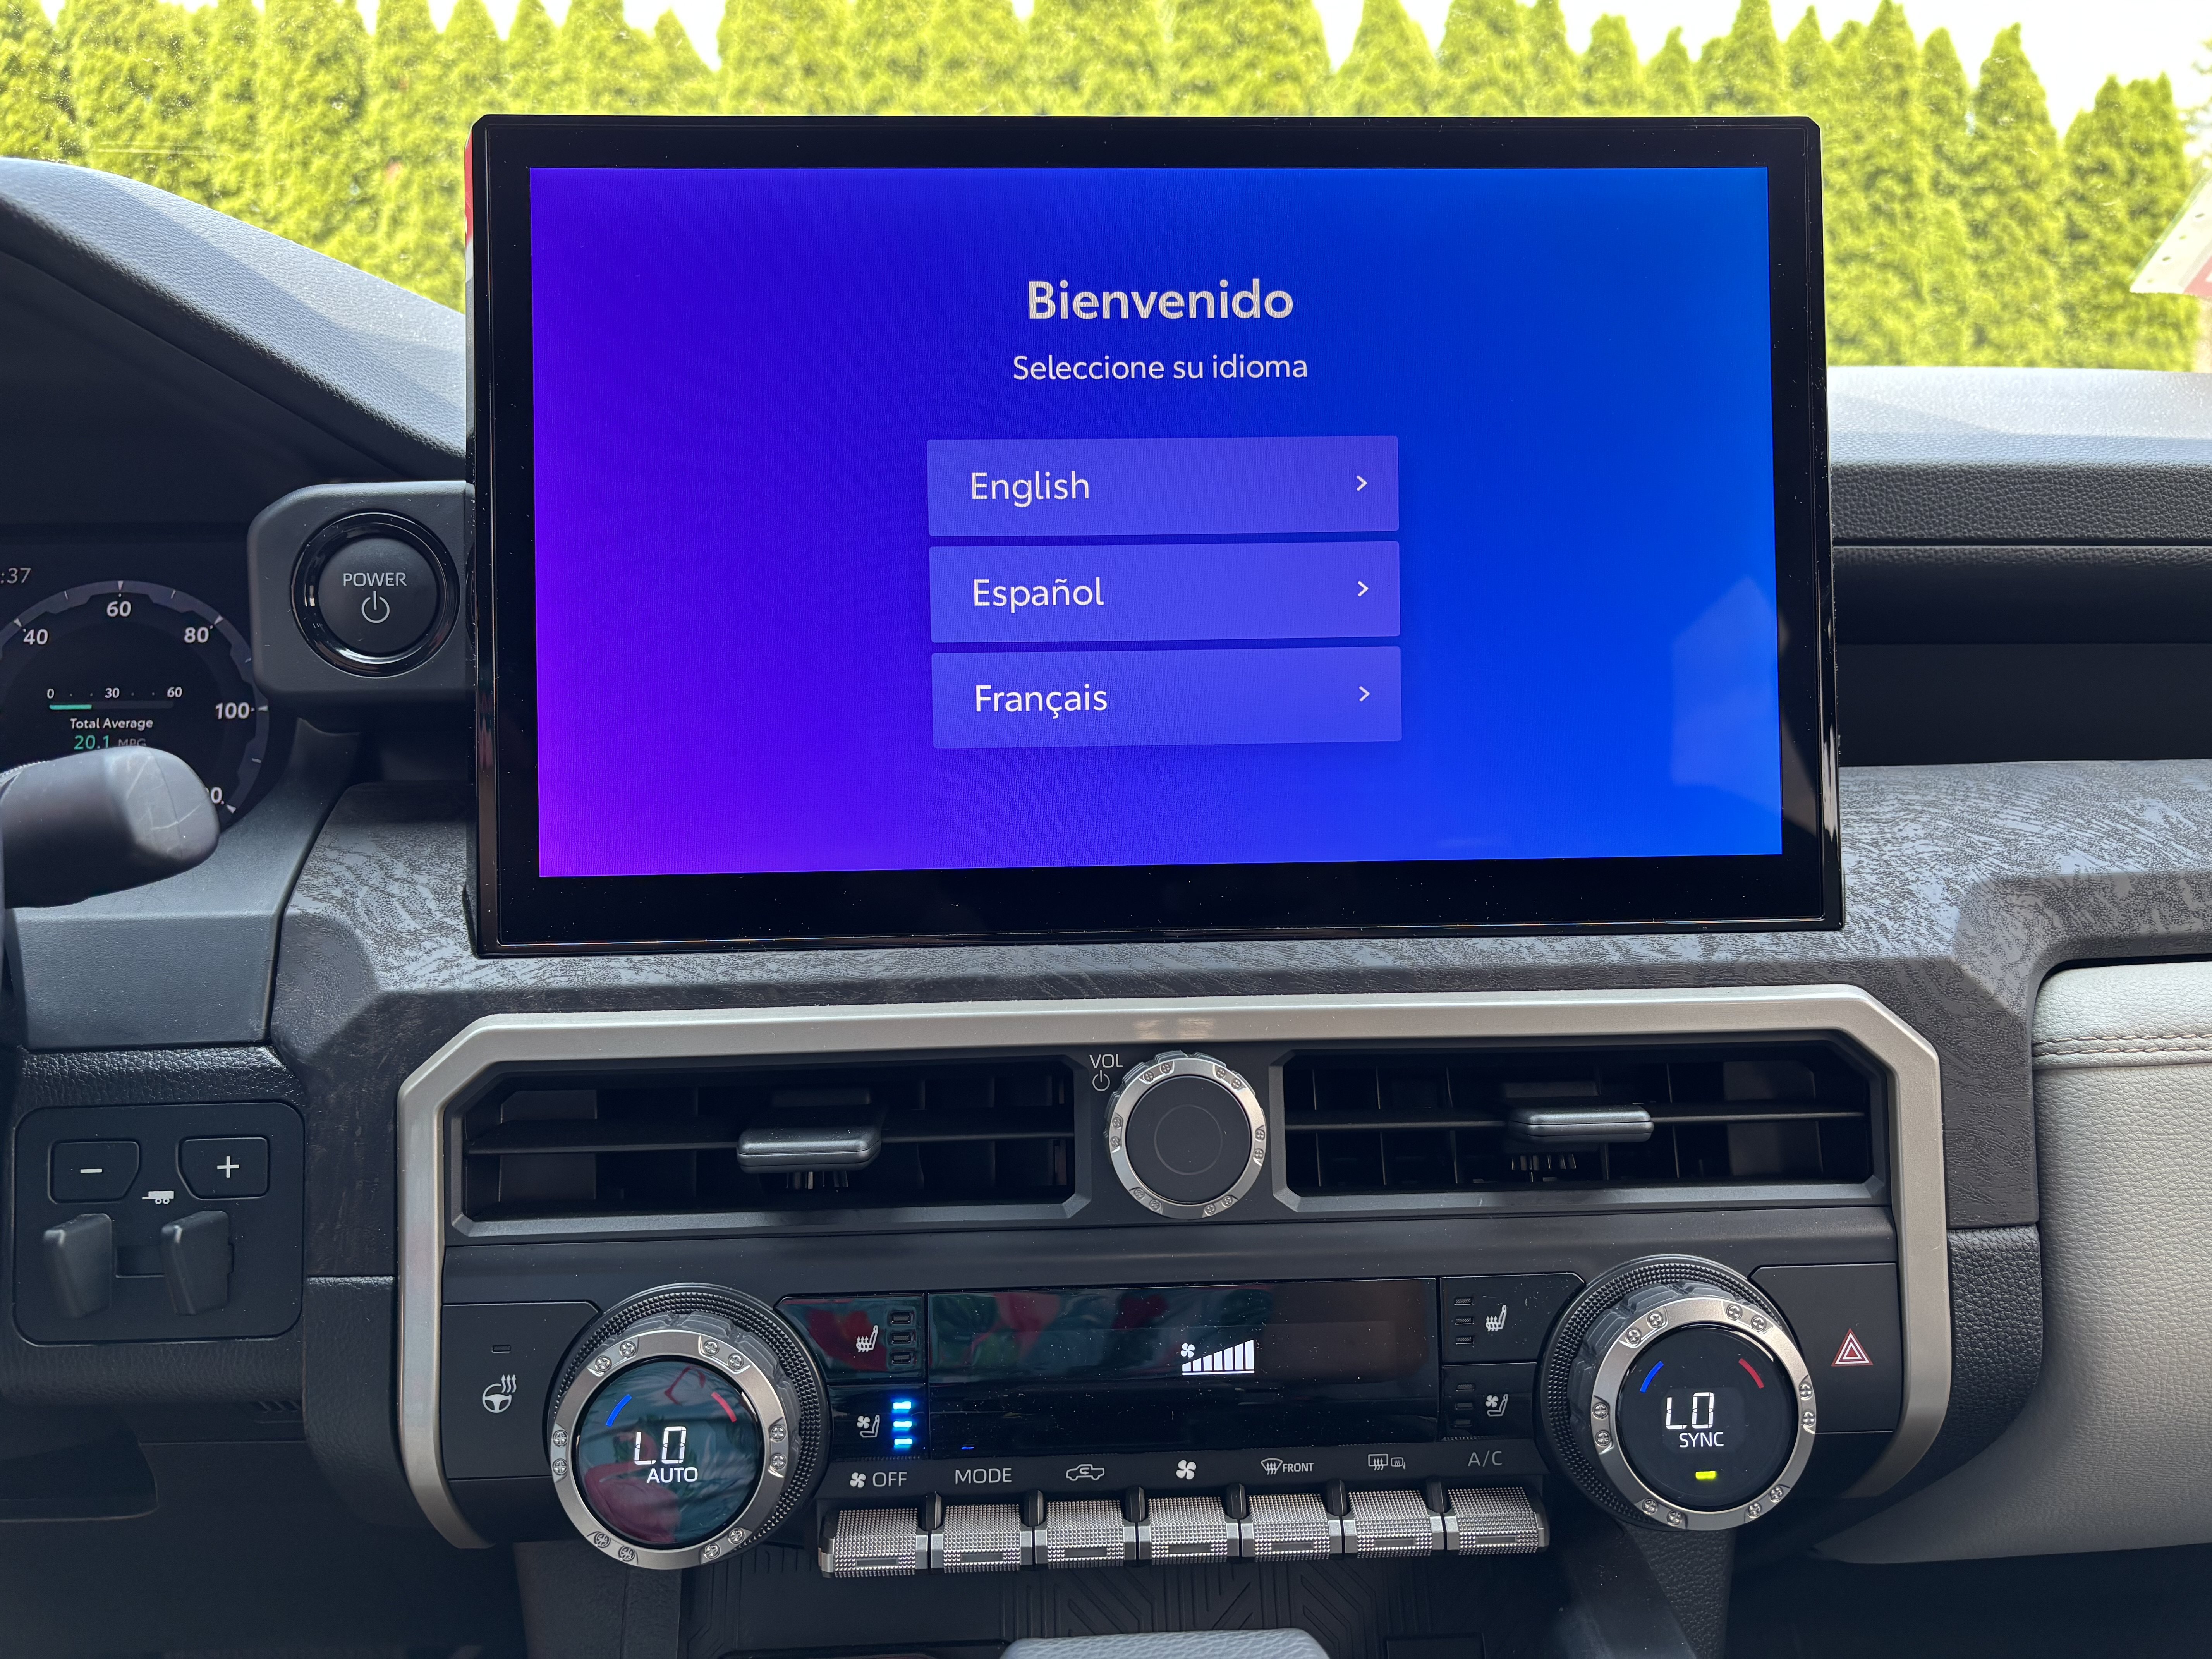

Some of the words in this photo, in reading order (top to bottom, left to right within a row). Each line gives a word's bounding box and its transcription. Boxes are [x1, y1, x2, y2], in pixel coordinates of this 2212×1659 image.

[1028, 278, 1294, 320] Bienvenido
[1013, 354, 1165, 380] Seleccione
[1173, 361, 1204, 379] su
[1212, 353, 1308, 379] idioma
[971, 470, 1089, 508] English
[343, 572, 407, 587] POWER
[973, 576, 1104, 614] Español
[106, 600, 132, 617] 60
[22, 628, 48, 645] 40
[183, 625, 210, 644] 80
[46, 688, 55, 699] 0
[104, 687, 120, 699] 30
[167, 686, 183, 698] 60
[975, 683, 1108, 720] Français
[215, 702, 250, 720] 100
[70, 717, 100, 729] Total
[102, 717, 153, 732] Average
[73, 734, 110, 751] 20.1
[117, 738, 147, 748] MPG
[1089, 1053, 1123, 1069] VOL
[1679, 1431, 1724, 1448] SYNC
[1281, 1461, 1315, 1473] FRONT
[1467, 1450, 1503, 1467] A/C
[646, 1467, 699, 1484] AUTO
[872, 1471, 907, 1487] OFF
[955, 1468, 1012, 1484] MODE
